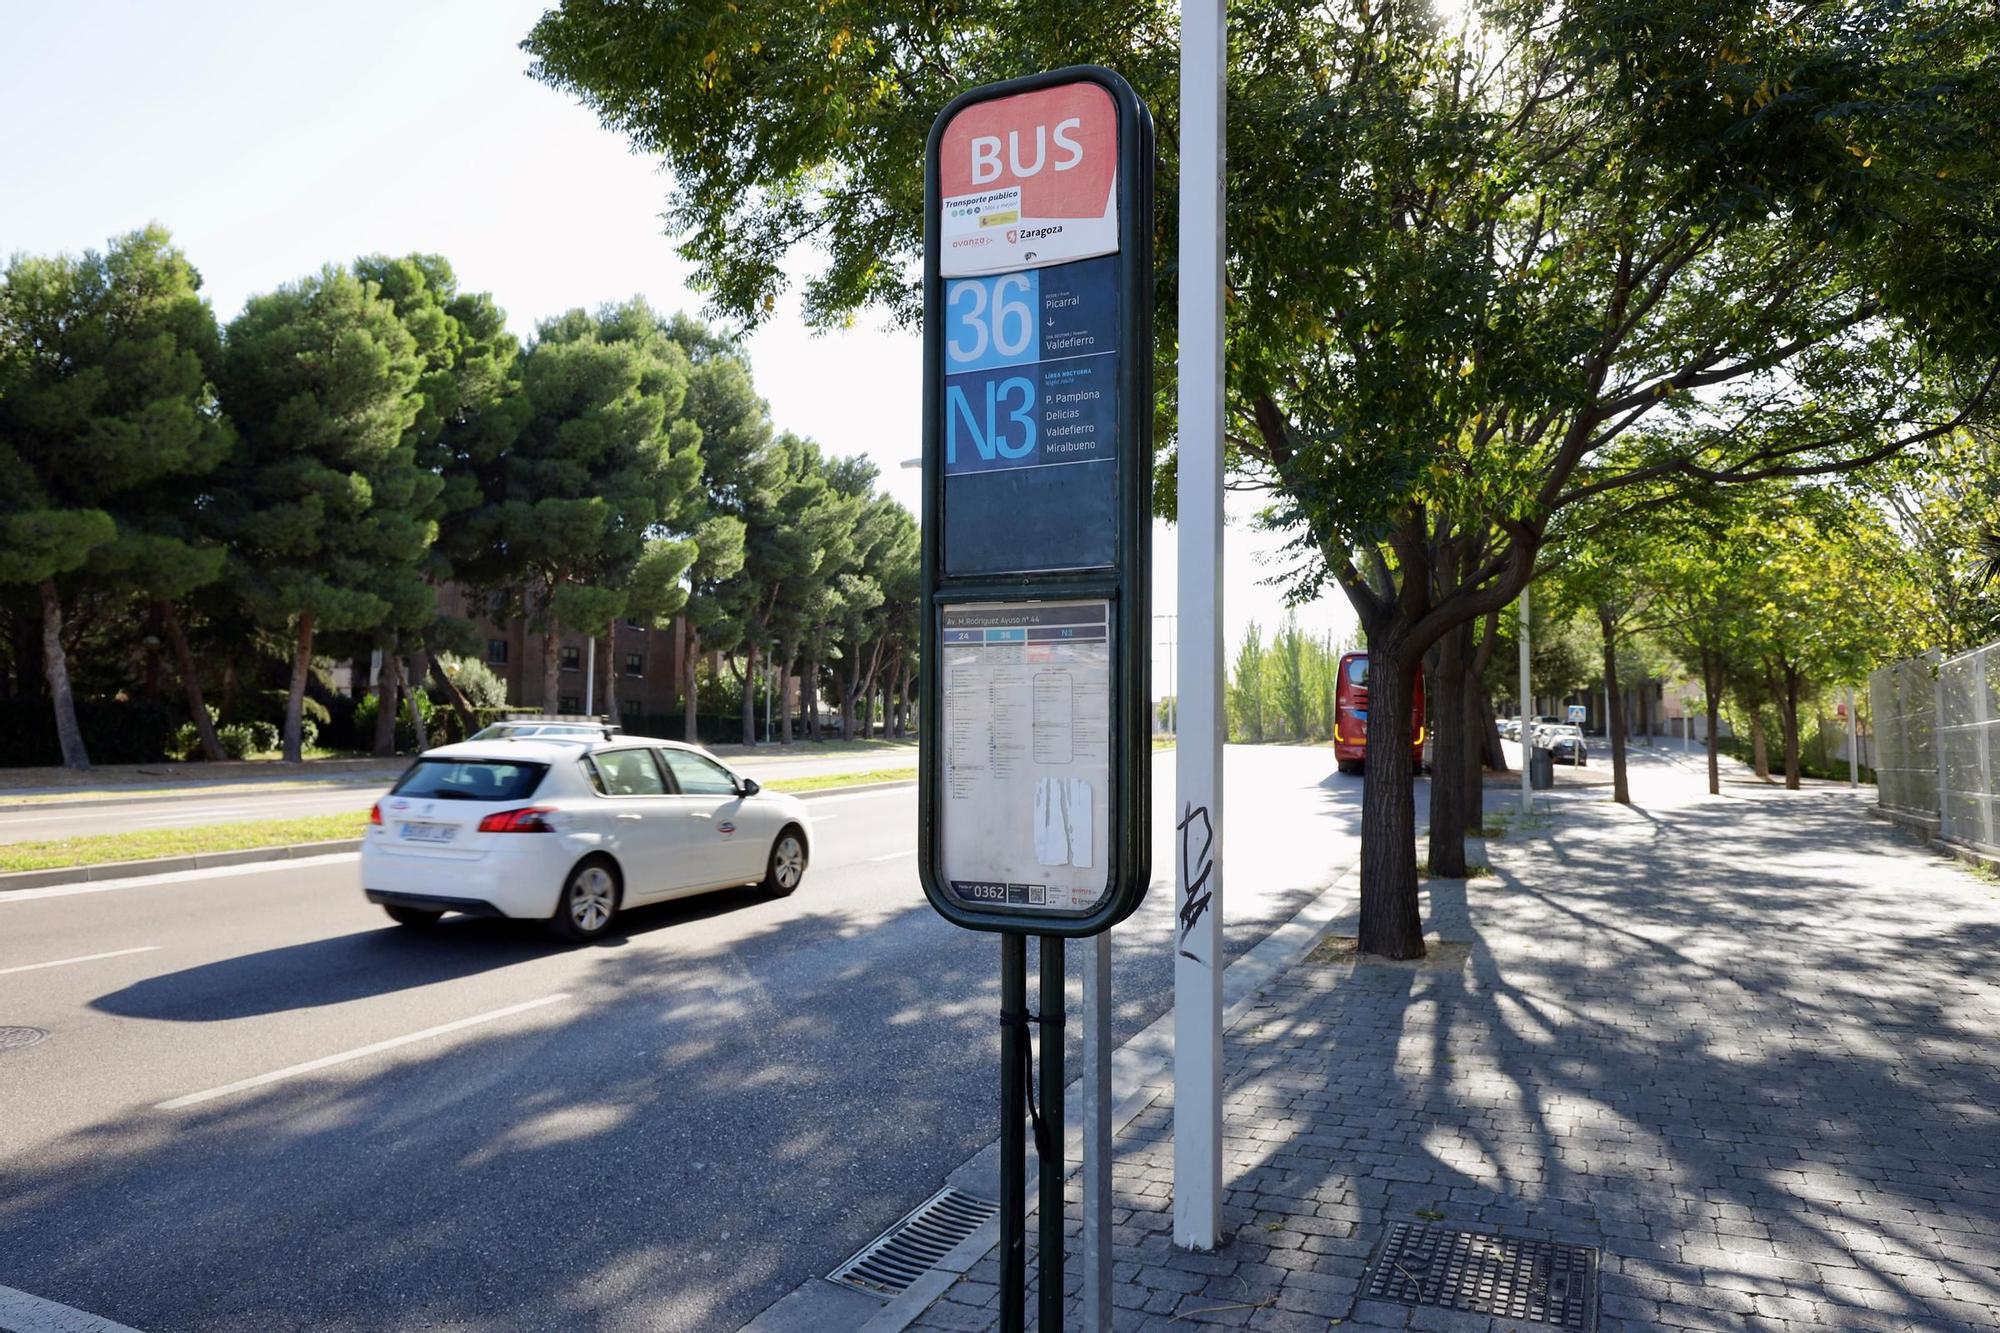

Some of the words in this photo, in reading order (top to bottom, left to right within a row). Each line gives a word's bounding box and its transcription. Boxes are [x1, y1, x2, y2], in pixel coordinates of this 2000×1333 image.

[971, 117, 1083, 185] BUS
[945, 196, 987, 208] Transporte
[988, 191, 1018, 203] público
[1020, 225, 1063, 239] Zaragoza
[952, 237, 985, 248] avanza
[1046, 295, 1080, 309] Picarral
[947, 273, 1033, 363] 36
[1046, 336, 1095, 350] Valdefierro
[1046, 395, 1054, 404] P.
[1056, 390, 1100, 404] Pamplona
[946, 376, 1037, 465] N3
[1046, 409, 1080, 421] Delicias
[1046, 424, 1095, 437] Valdefierro
[1046, 441, 1096, 454] Miralbueno
[1000, 616, 1020, 625] Ayuso
[974, 885, 1004, 899] 0362
